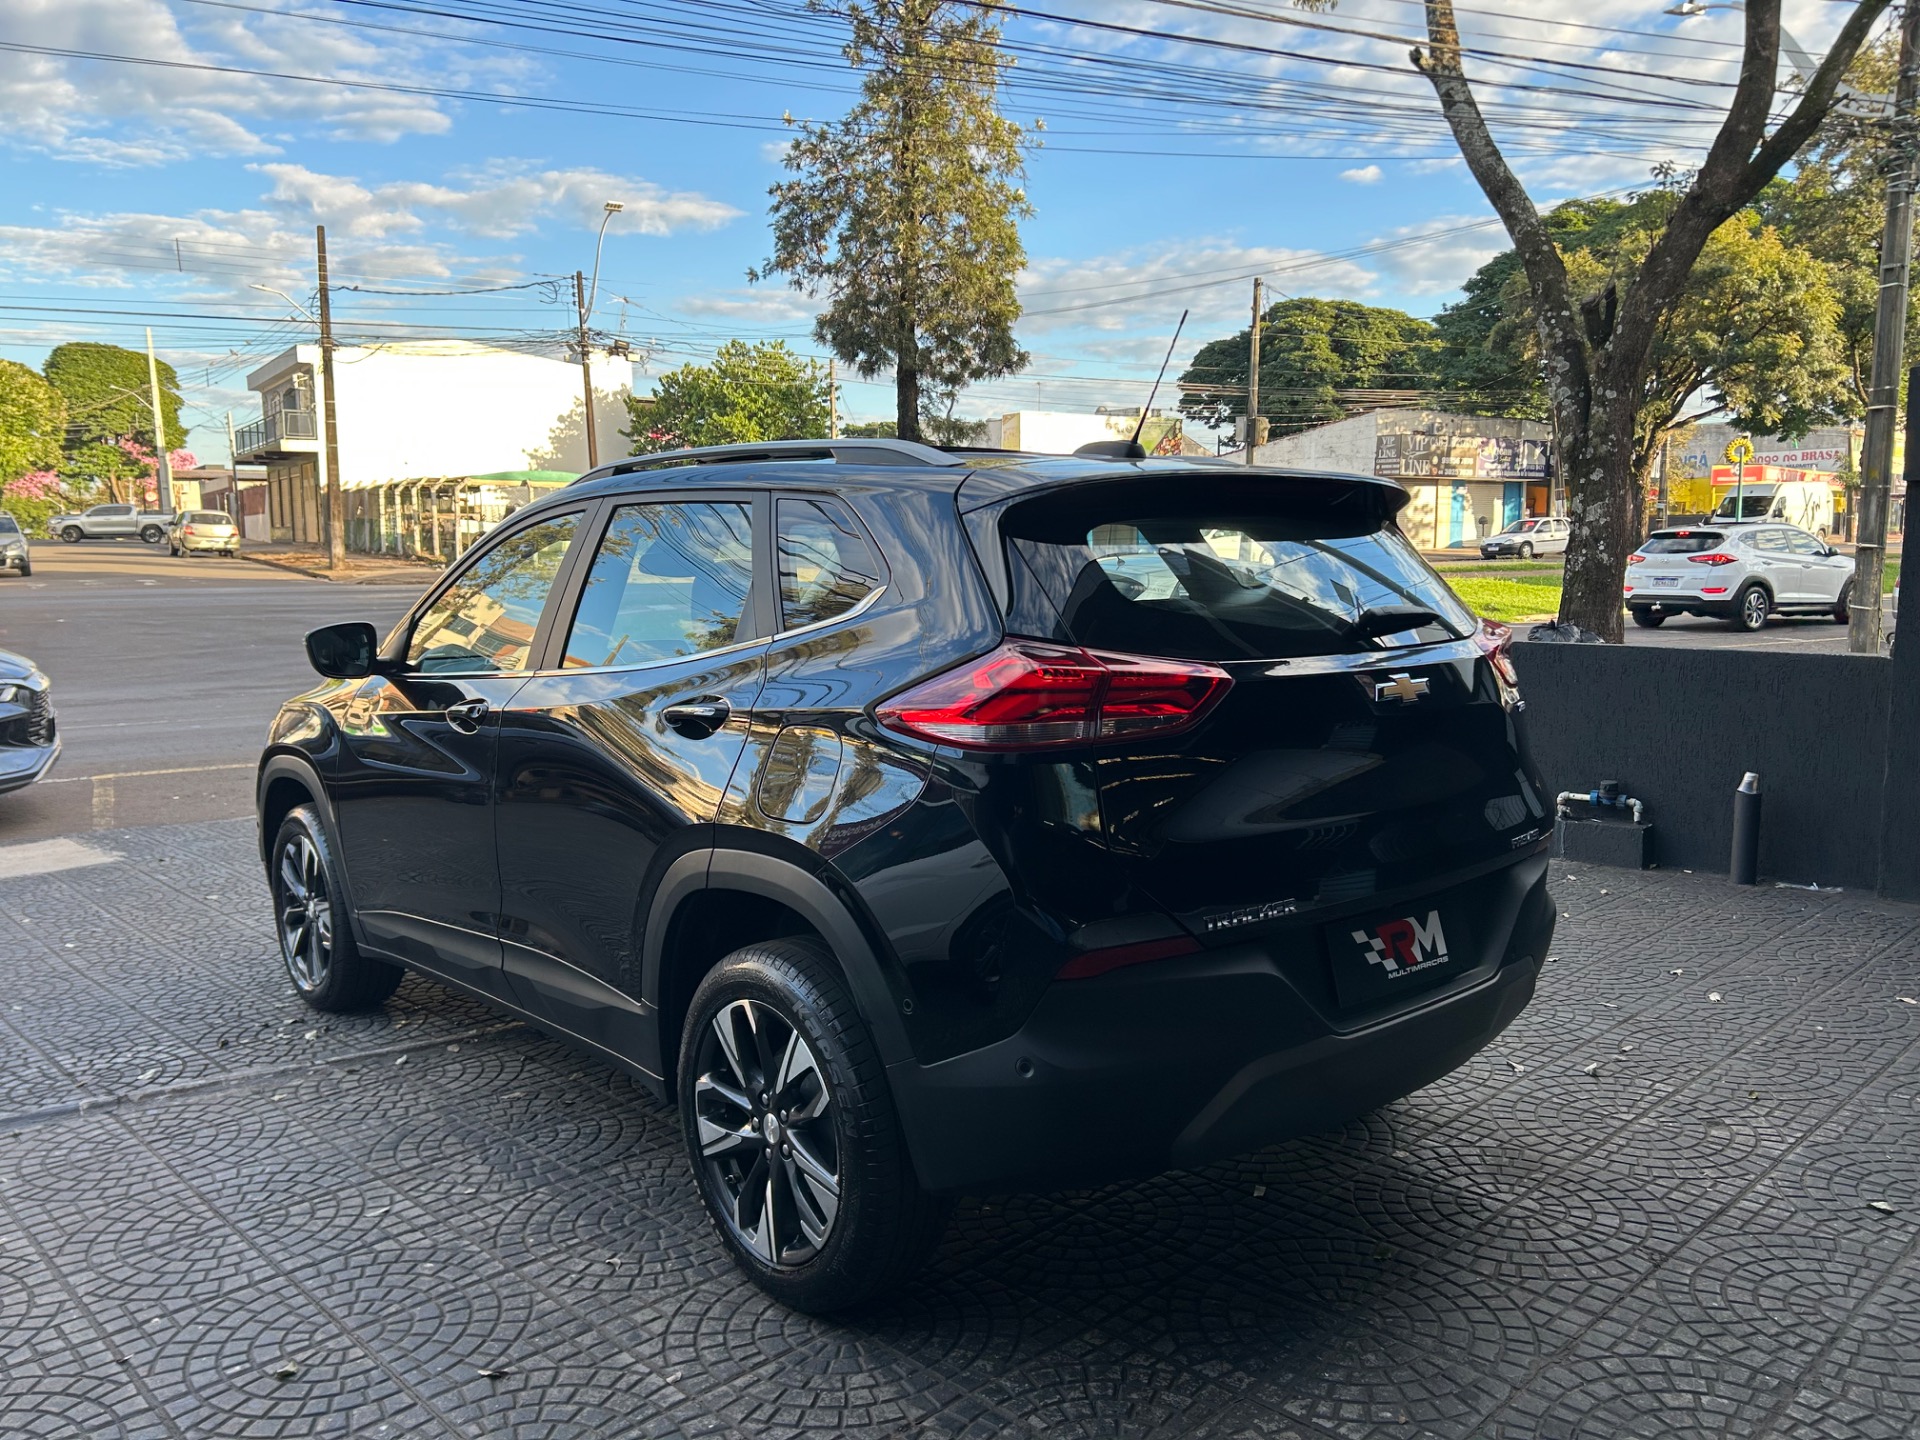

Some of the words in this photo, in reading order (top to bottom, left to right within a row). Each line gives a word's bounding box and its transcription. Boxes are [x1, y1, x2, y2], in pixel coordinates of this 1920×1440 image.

[1382, 437, 1395, 445] VIP
[1408, 435, 1429, 451] VIP
[1378, 449, 1397, 459] LINE
[1783, 454, 1798, 462] na
[1400, 458, 1431, 475] LINE
[1203, 898, 1297, 931] TRACKER
[1376, 910, 1448, 965] RM
[1387, 955, 1449, 980] MULTIMARCAS
